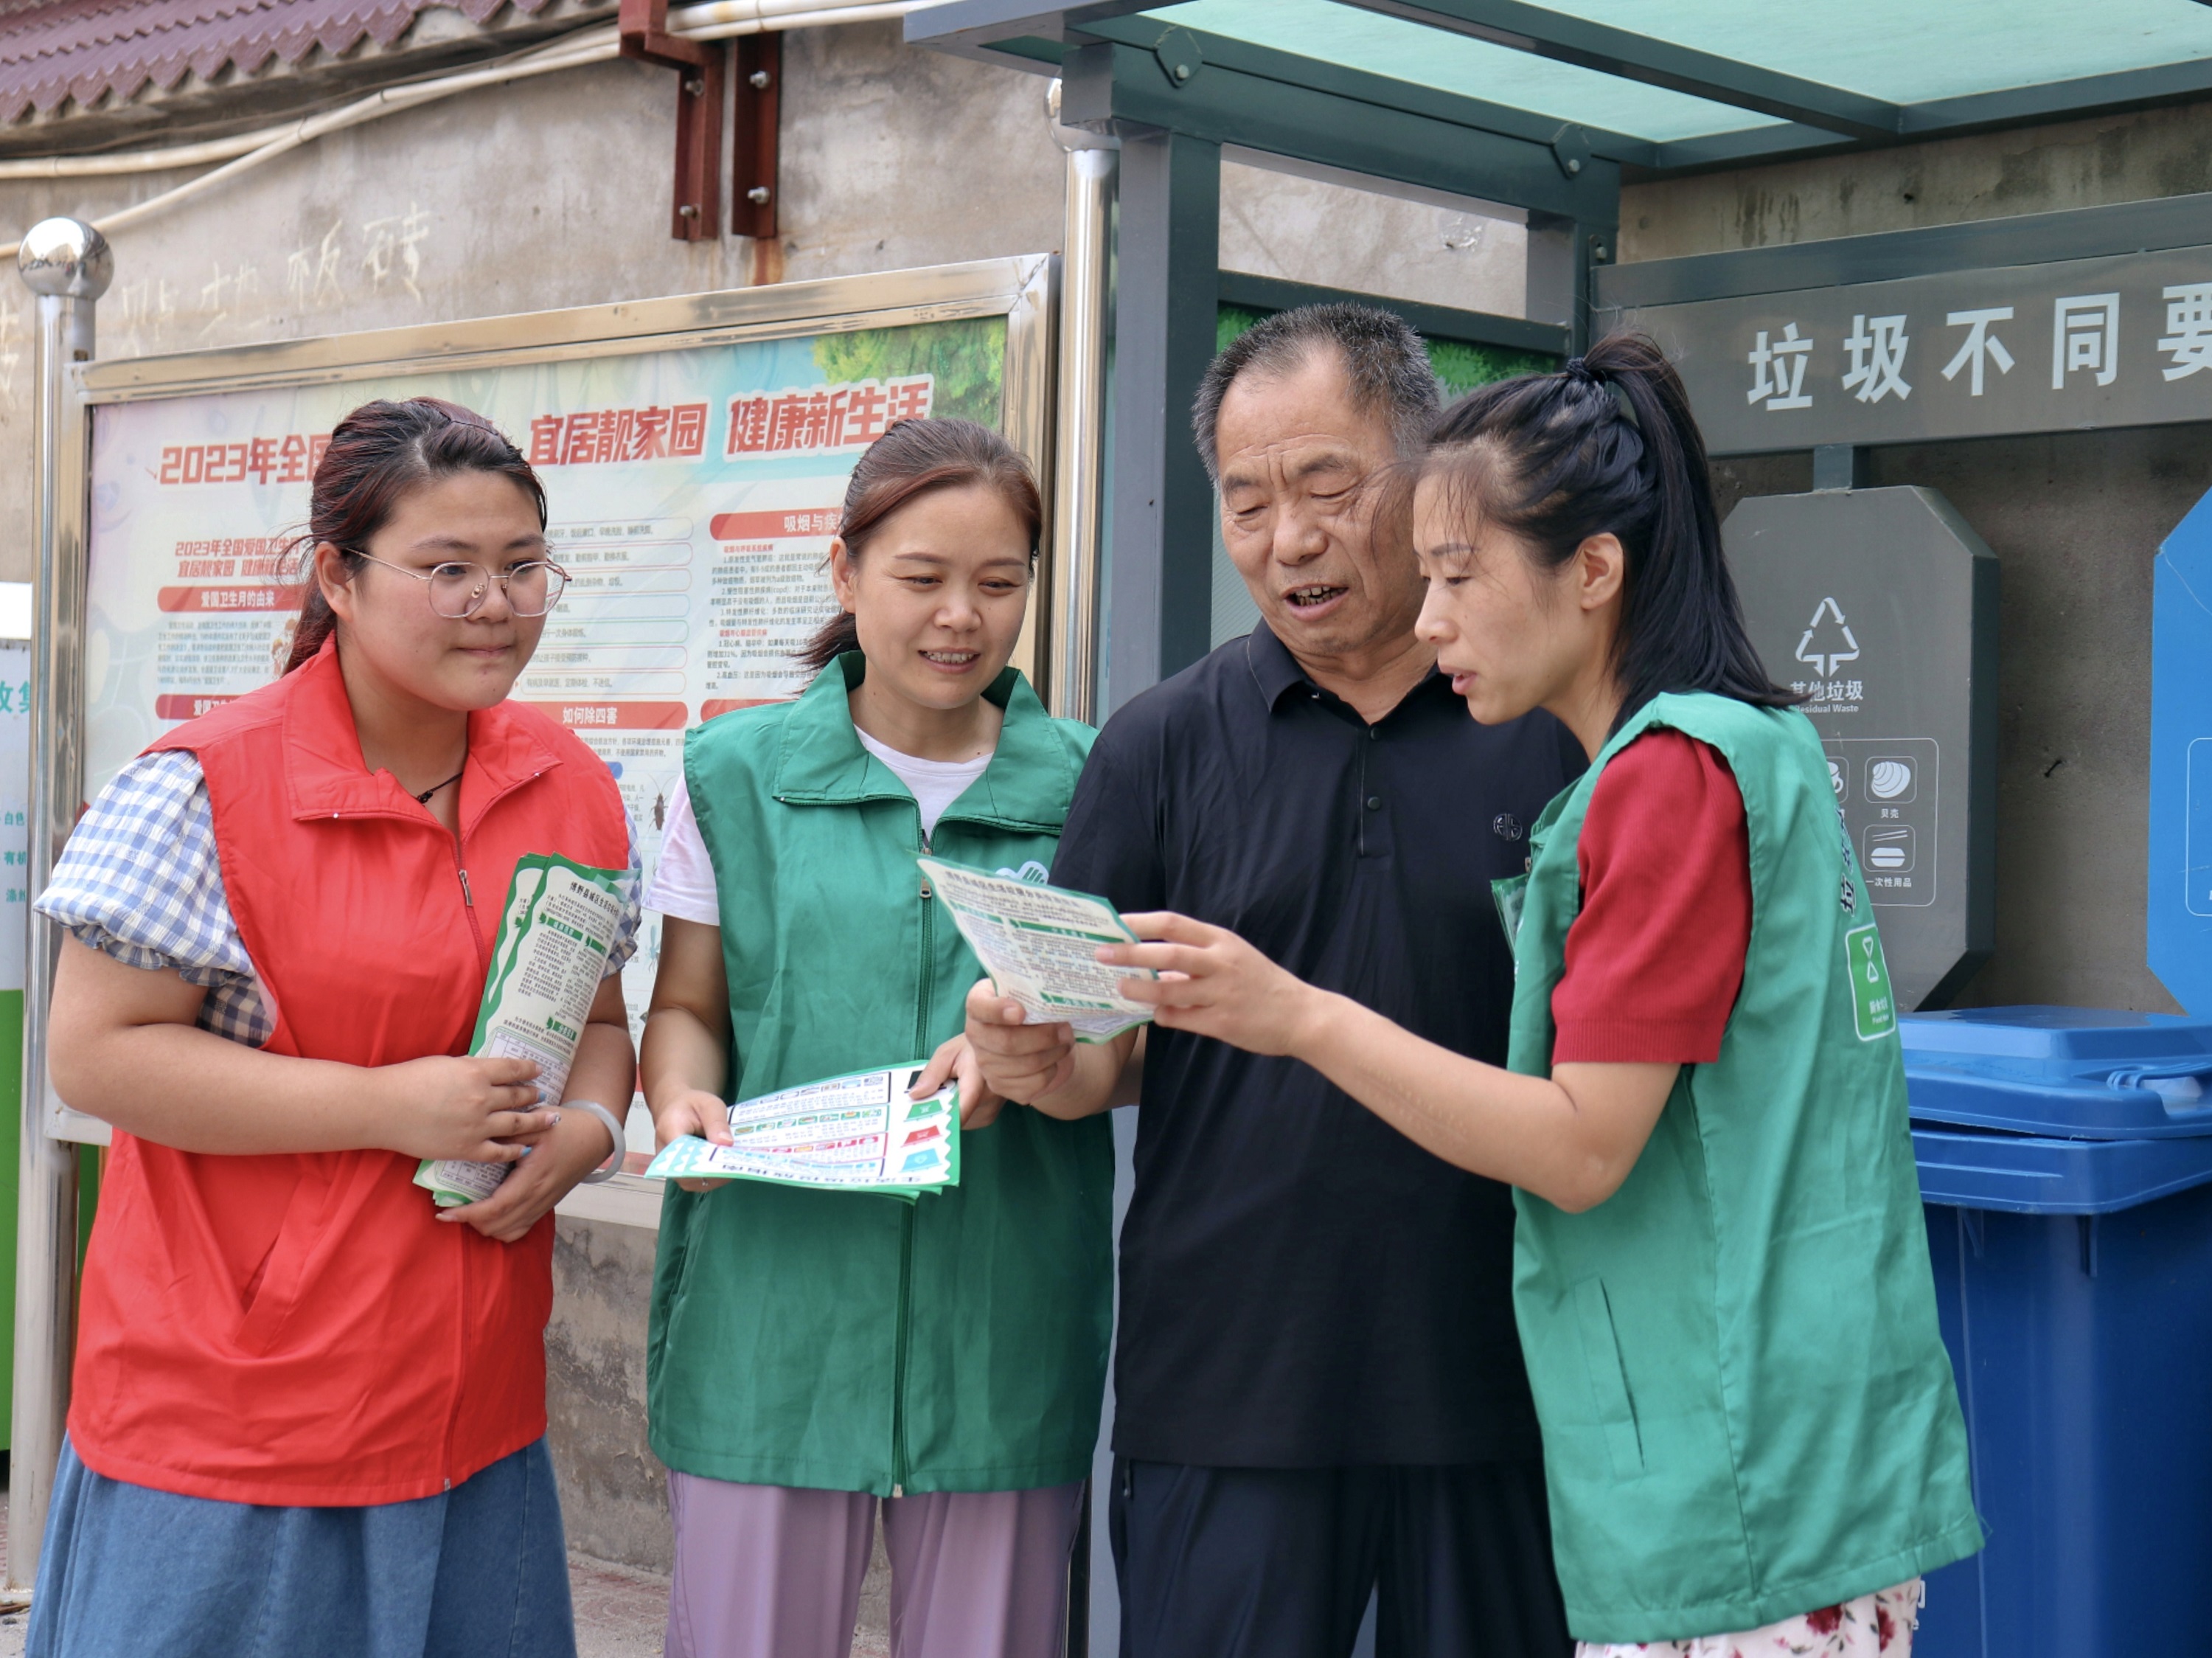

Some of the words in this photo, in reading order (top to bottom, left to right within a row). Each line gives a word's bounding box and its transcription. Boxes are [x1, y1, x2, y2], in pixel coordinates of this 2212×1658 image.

[529, 403, 708, 466] 宜居靓家园
[727, 382, 931, 454] 健康新生活
[201, 591, 274, 608] 爱国卫生月的由来
[1790, 679, 1864, 701] 其他垃圾
[563, 707, 618, 724] 如何除四害
[1798, 704, 1831, 714] esidual
[1832, 703, 1860, 713] Waste
[1881, 808, 1899, 819] 贝壳
[1865, 877, 1912, 888] 一次性用品
